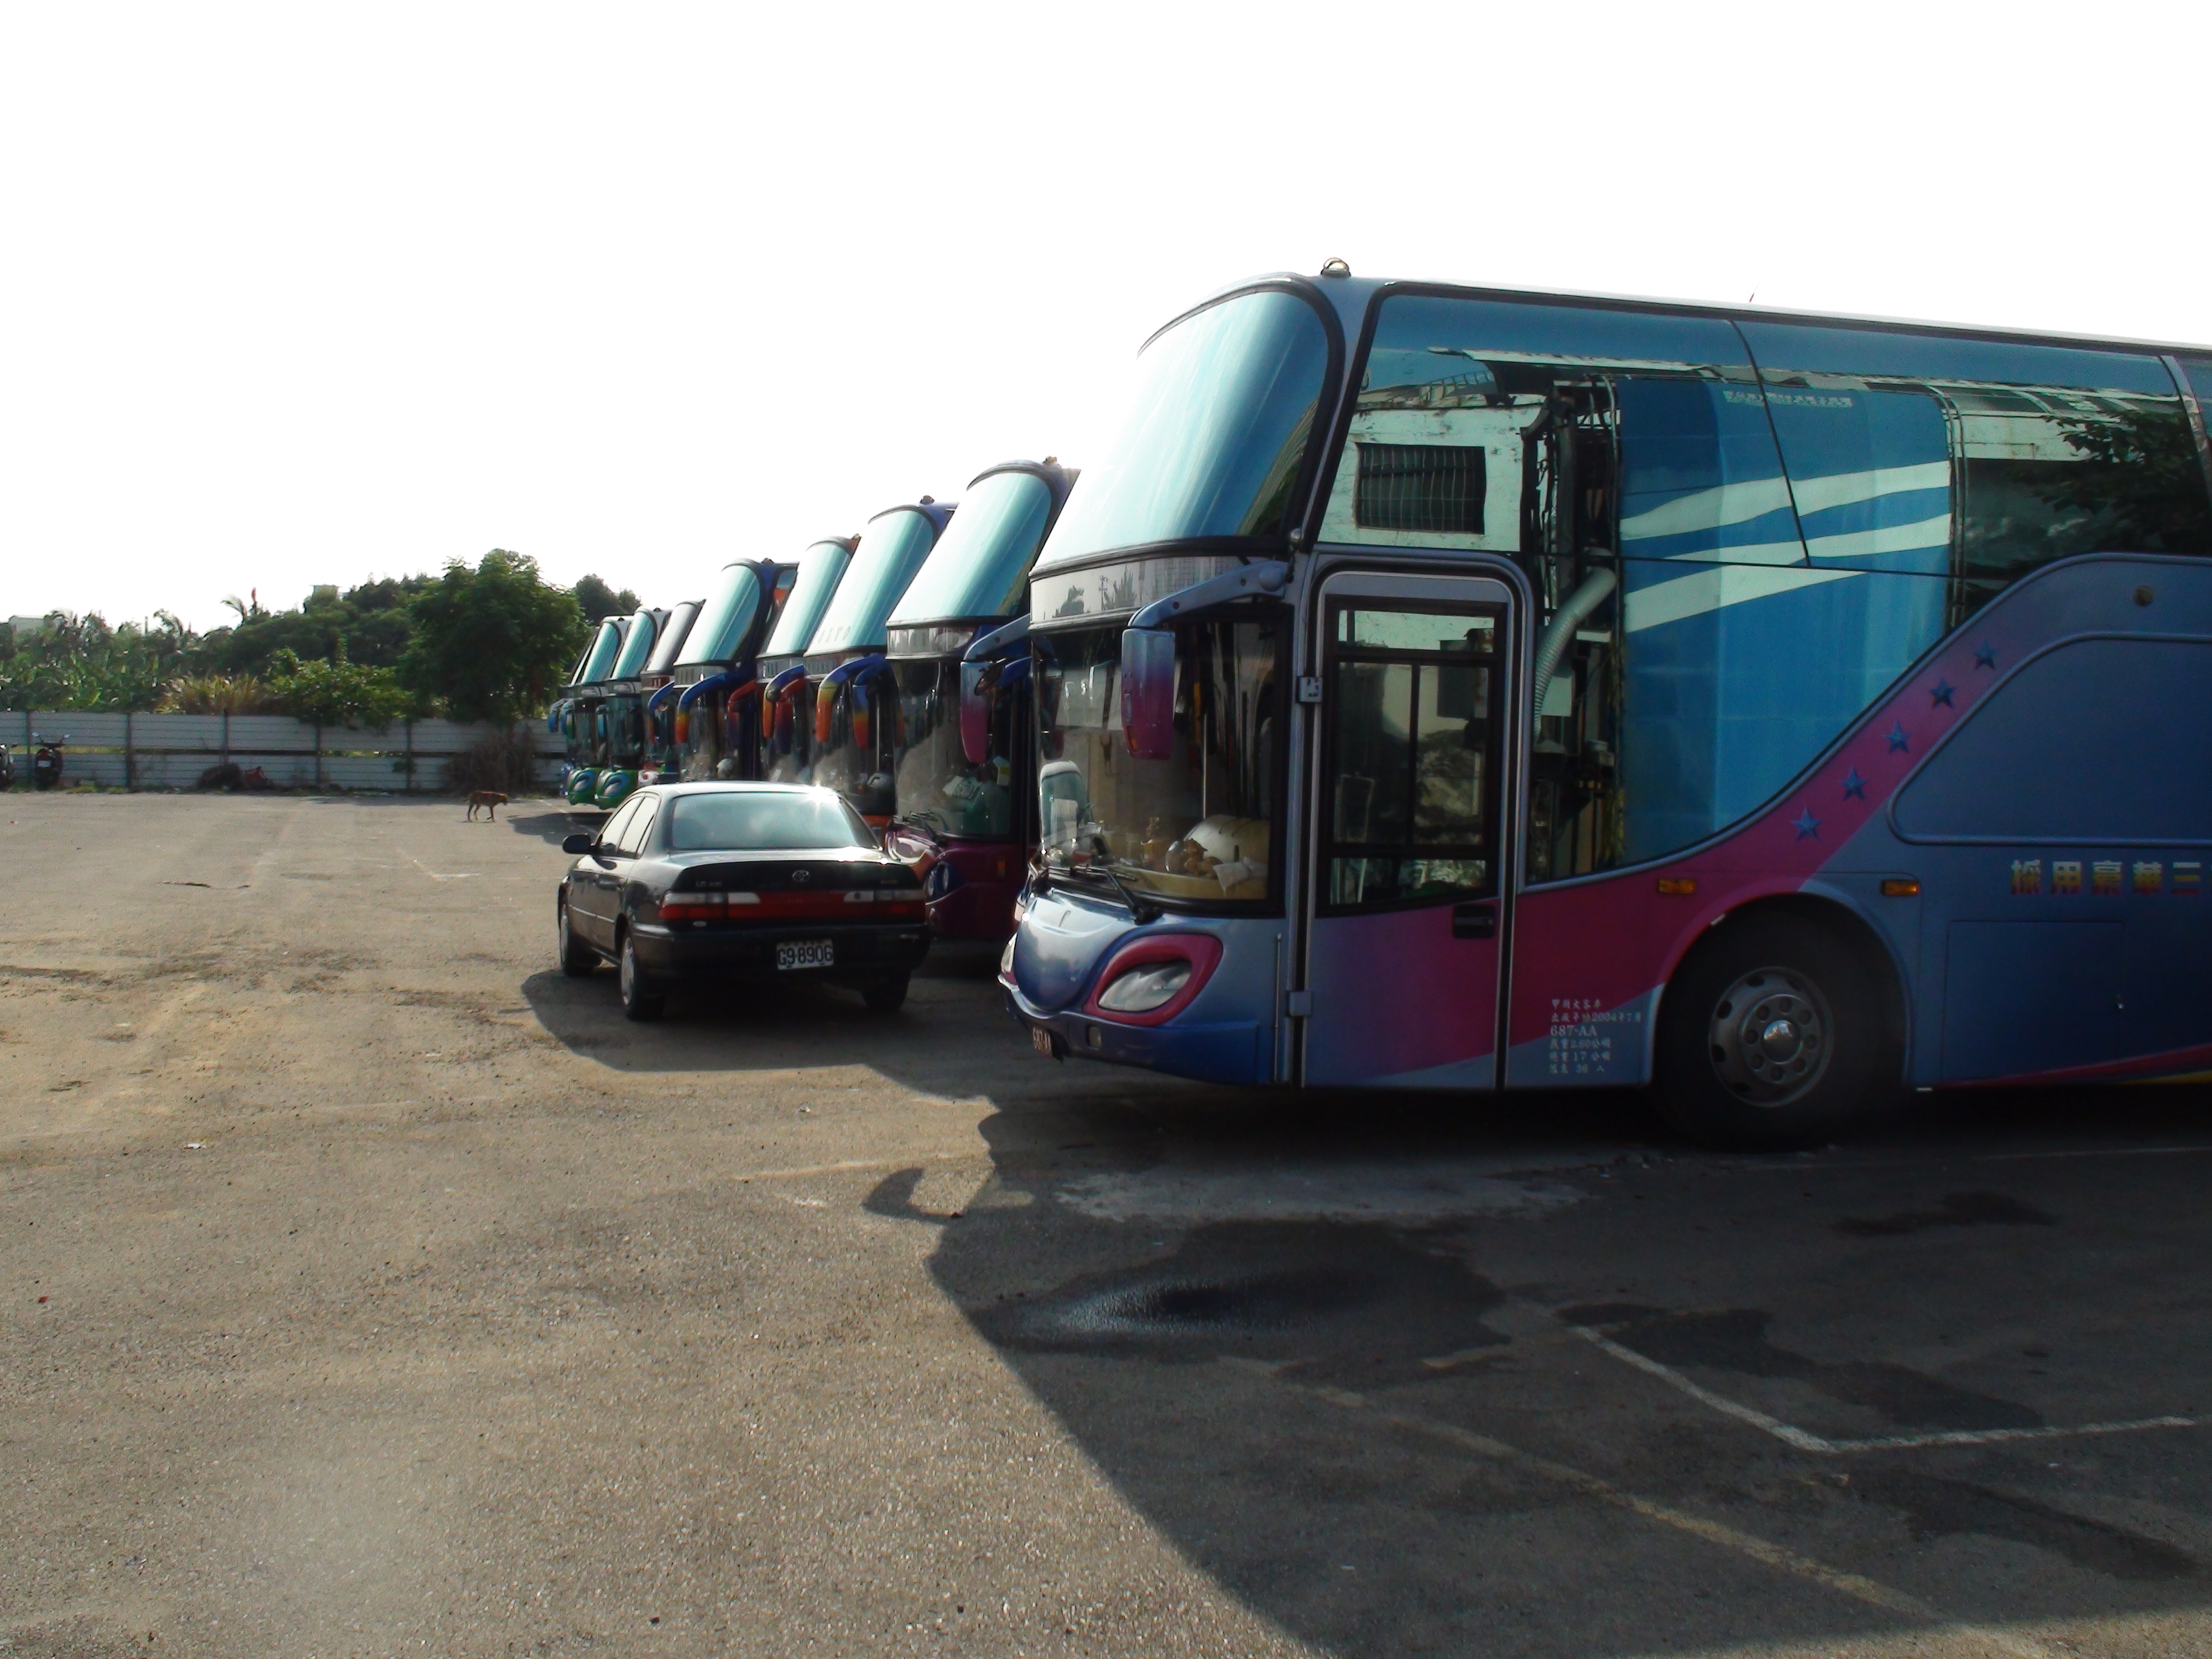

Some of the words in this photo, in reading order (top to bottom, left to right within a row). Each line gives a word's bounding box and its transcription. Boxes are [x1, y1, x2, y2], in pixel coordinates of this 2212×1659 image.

[2011, 859, 2212, 894] 採用豪華三
[778, 945, 833, 966] G9-8906
[1550, 1025, 1598, 1037] 687-AA
